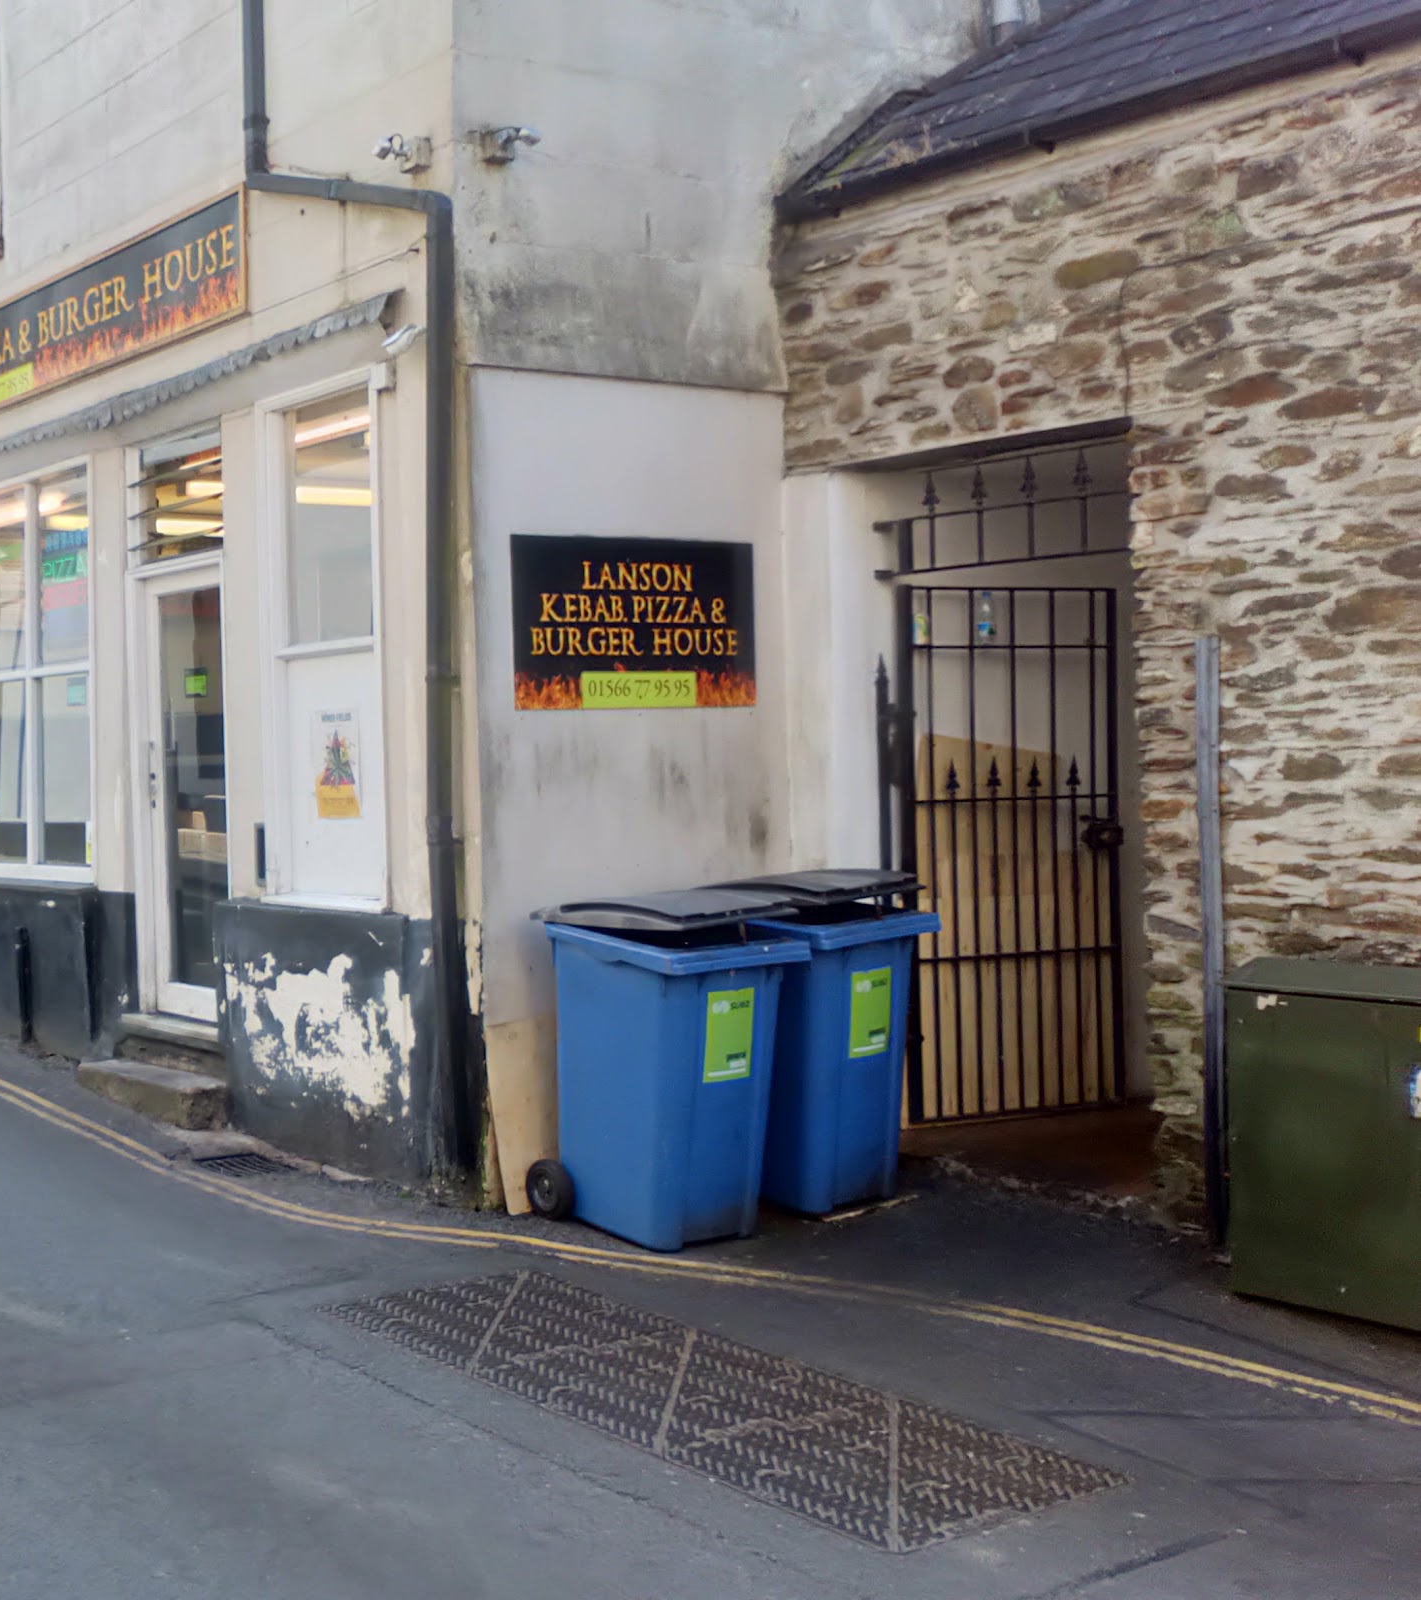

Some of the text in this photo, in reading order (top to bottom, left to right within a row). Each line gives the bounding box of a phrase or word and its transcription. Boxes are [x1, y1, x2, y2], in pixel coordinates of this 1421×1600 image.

[18, 319, 32, 355] &
[37, 274, 135, 348] BURGER
[142, 223, 238, 304] HOUSE
[581, 560, 694, 592] LANSON
[632, 595, 707, 624] PIZZA
[711, 597, 727, 624] &
[530, 626, 739, 656] BURGER HOUSE
[588, 679, 691, 699] 01566 77 95 95
